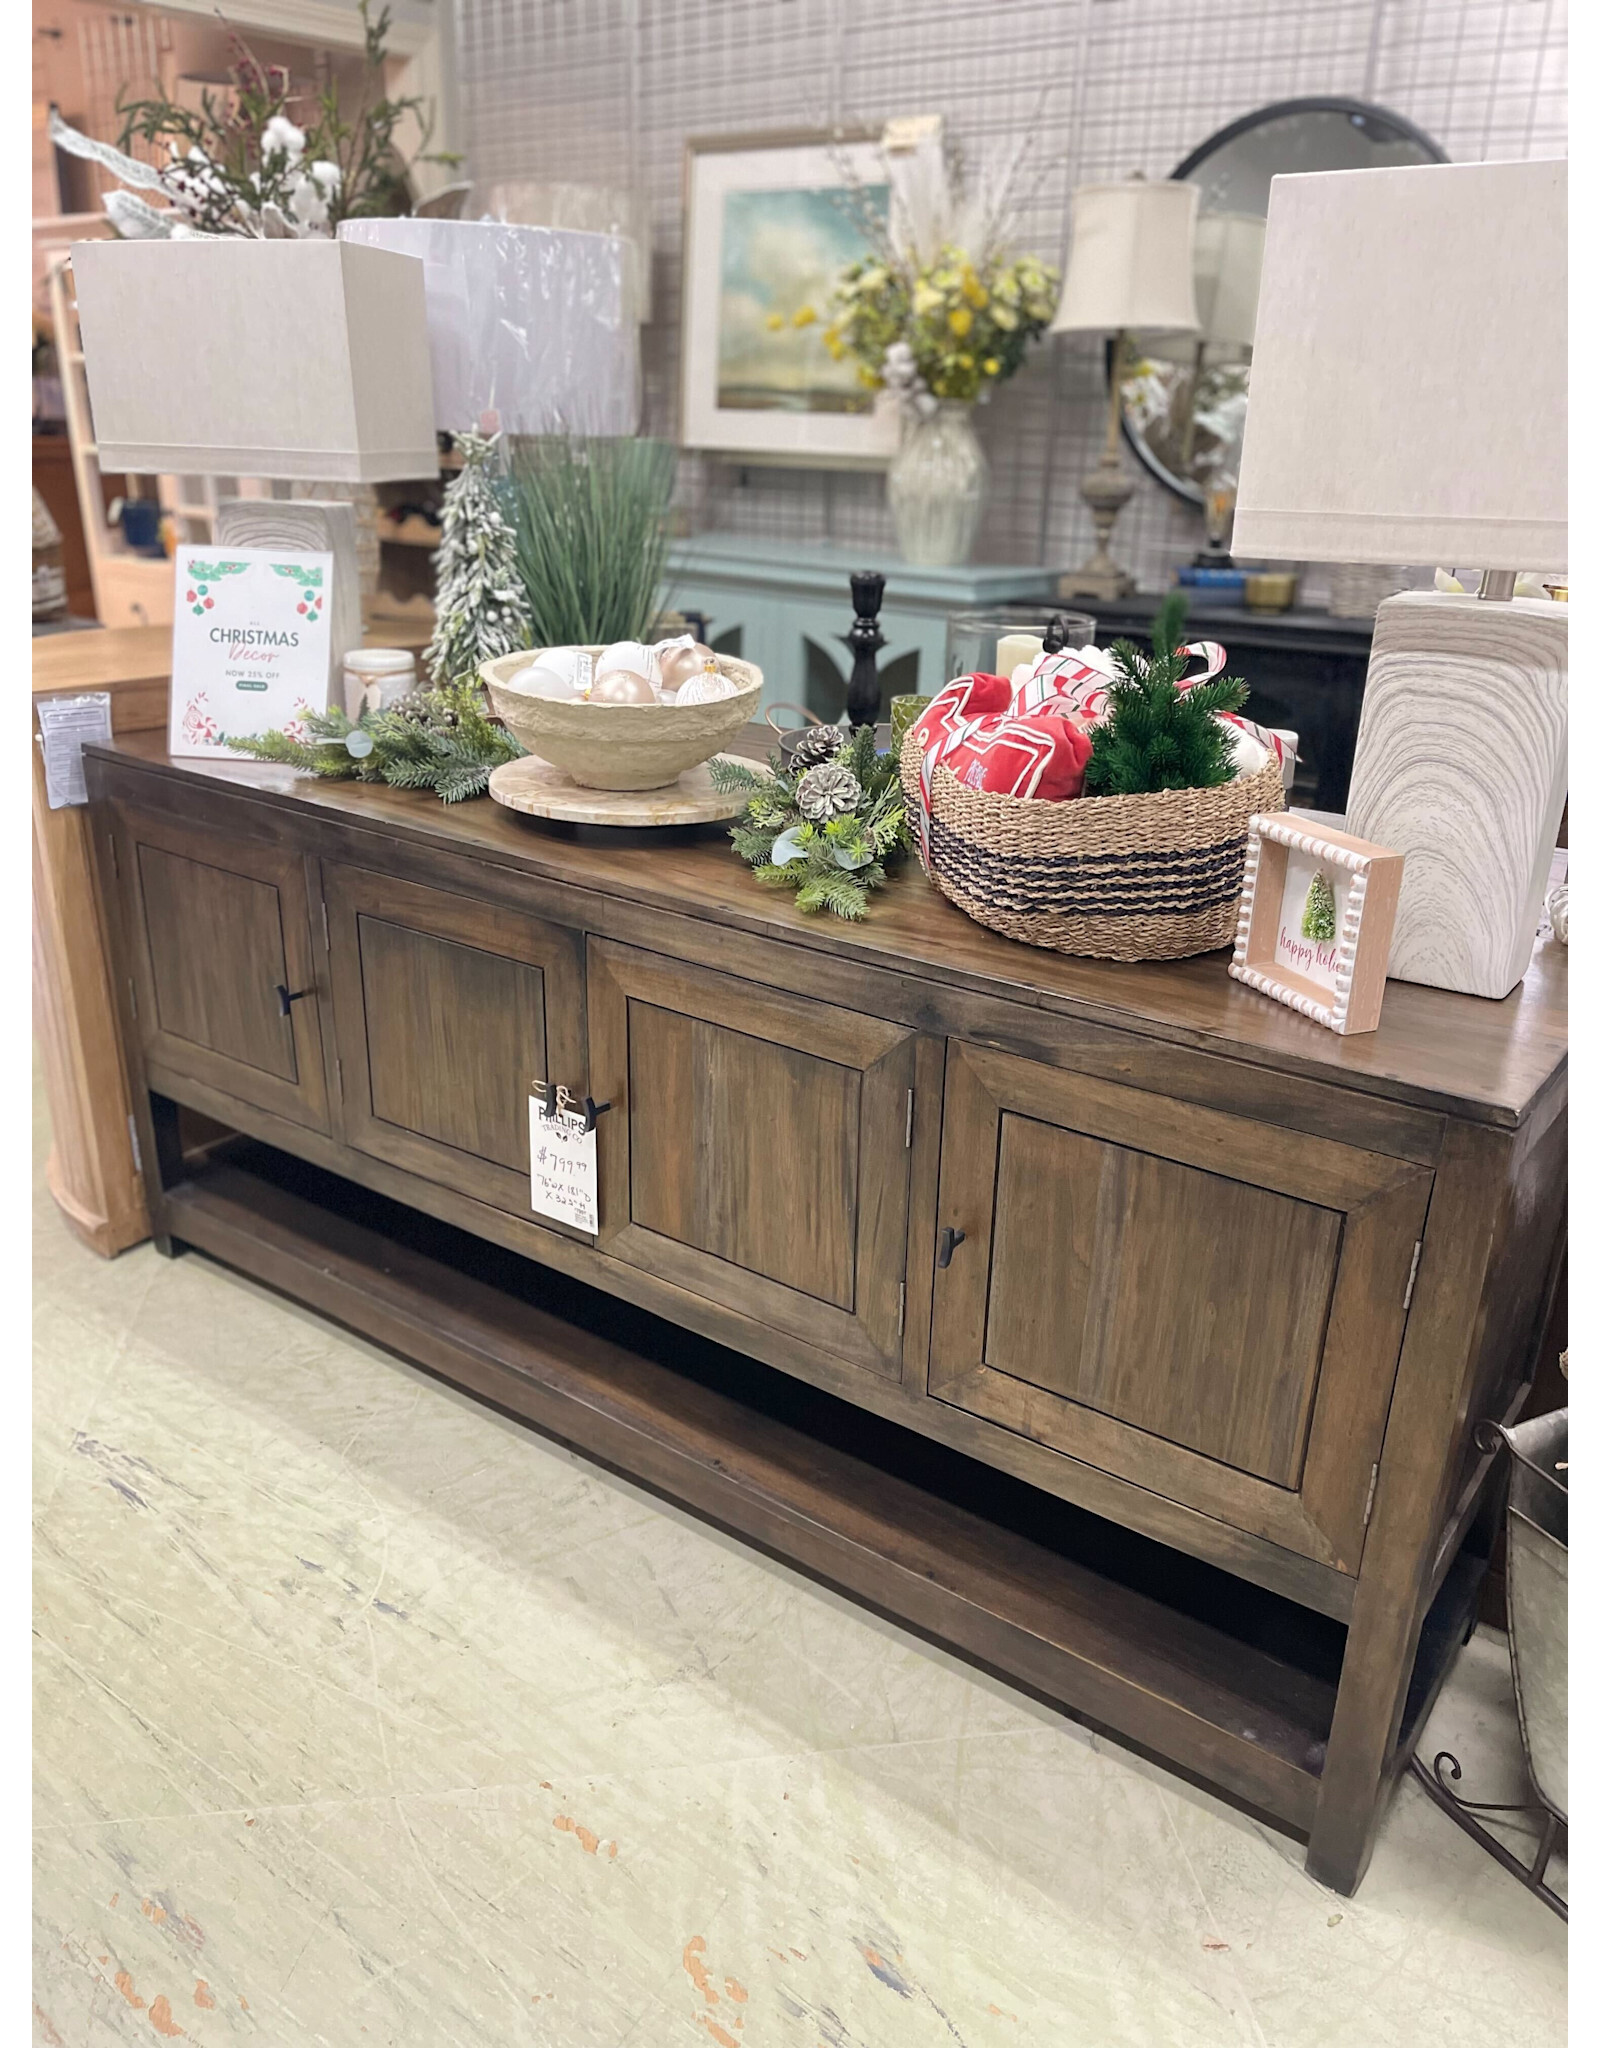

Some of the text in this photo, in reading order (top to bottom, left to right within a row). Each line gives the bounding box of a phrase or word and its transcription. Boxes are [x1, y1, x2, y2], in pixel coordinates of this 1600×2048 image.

[210, 627, 299, 647] CHRISTMAS
[229, 640, 279, 662] Decor
[265, 671, 280, 679] OFF
[1280, 926, 1314, 971] happy
[542, 1124, 572, 1137] TRADING
